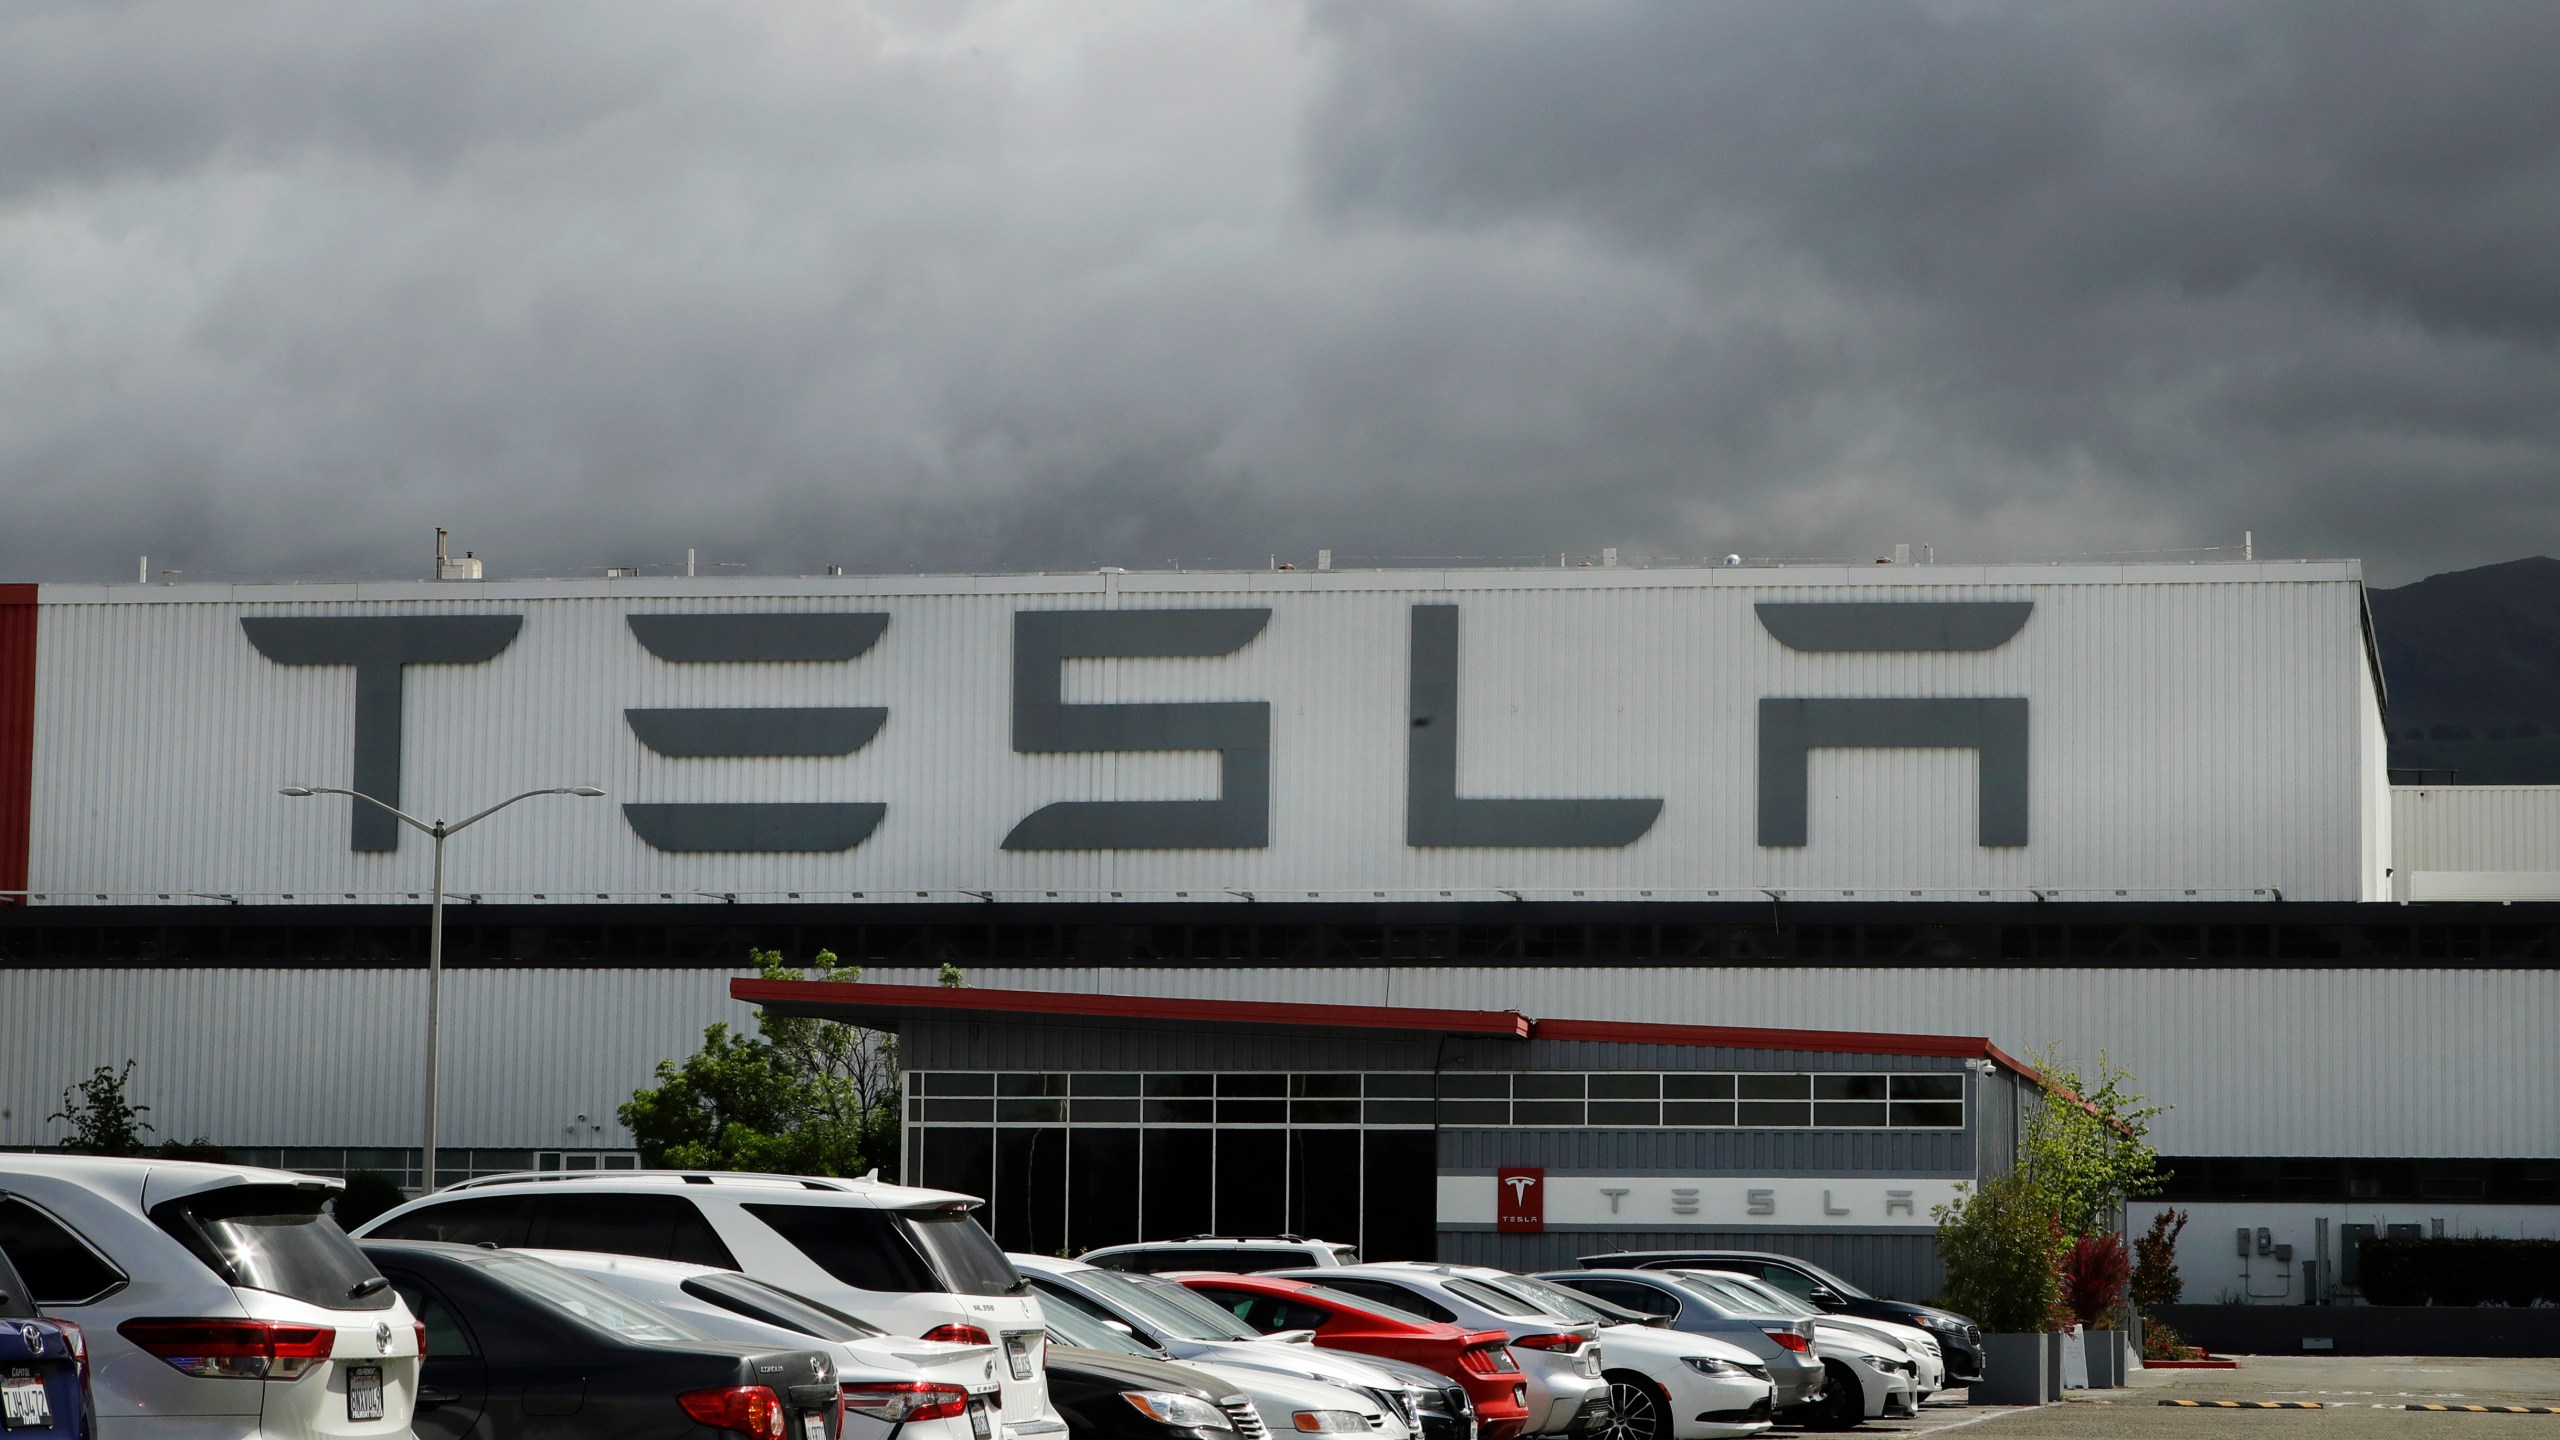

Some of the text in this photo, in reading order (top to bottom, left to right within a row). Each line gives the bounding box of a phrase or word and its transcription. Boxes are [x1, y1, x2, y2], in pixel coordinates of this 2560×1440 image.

[240, 603, 2034, 853] TESLA
[1600, 1189, 1914, 1216] TESLA
[11, 1367, 30, 1377] CAPITOL
